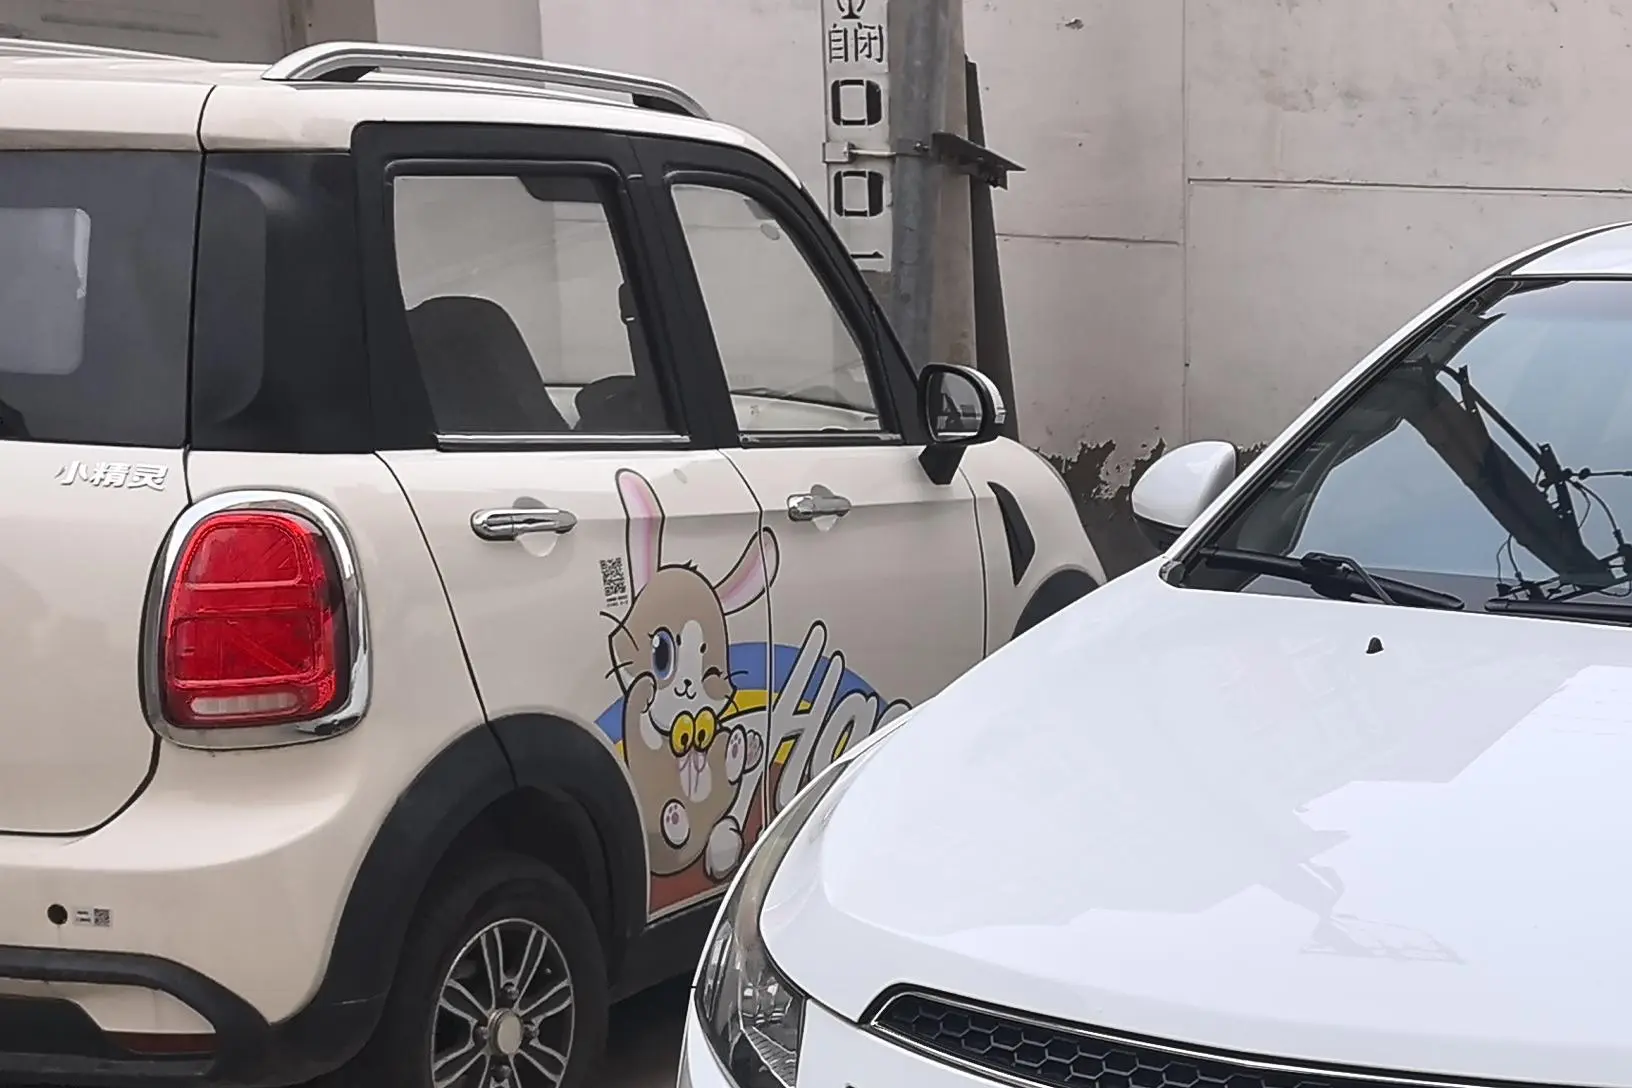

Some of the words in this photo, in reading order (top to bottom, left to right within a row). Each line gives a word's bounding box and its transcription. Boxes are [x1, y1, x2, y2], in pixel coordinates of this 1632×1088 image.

[828, 22, 885, 64] 自闭
[54, 460, 169, 491] 小精灵
